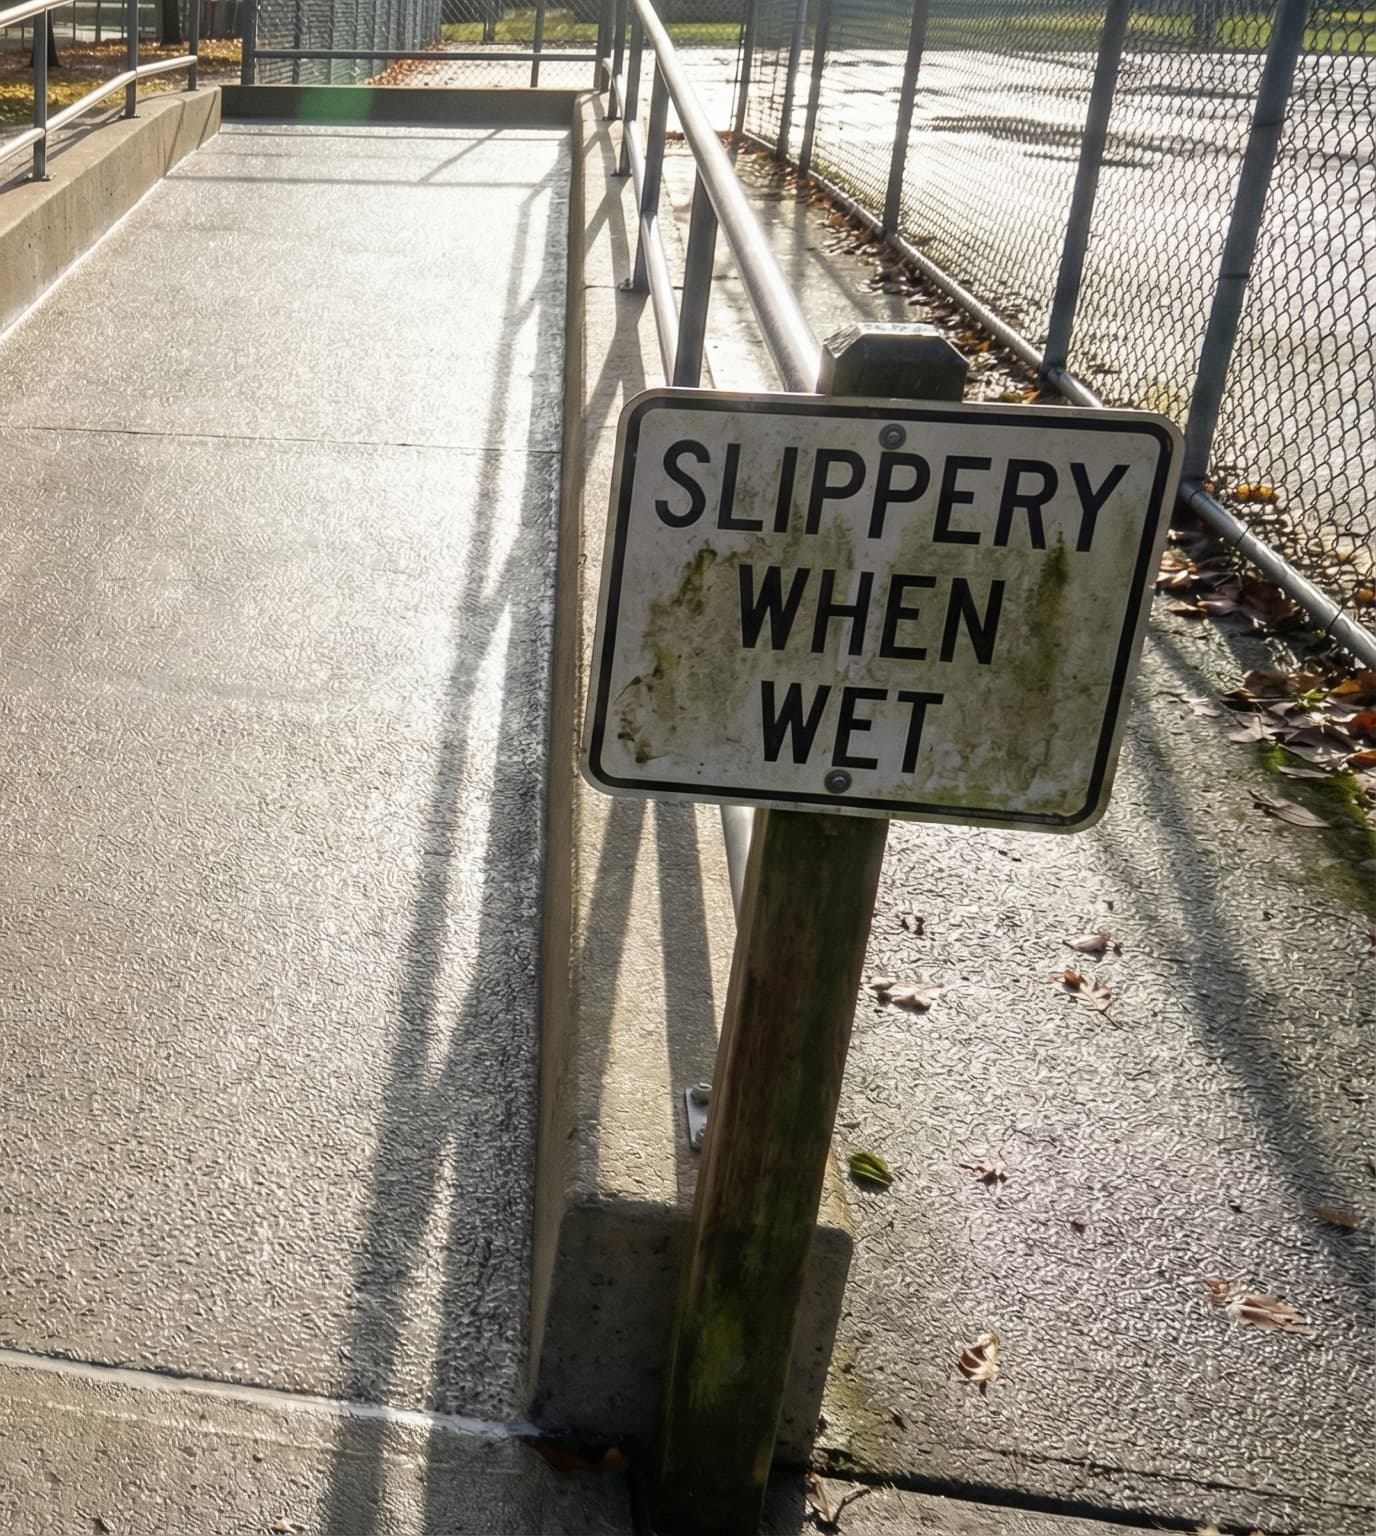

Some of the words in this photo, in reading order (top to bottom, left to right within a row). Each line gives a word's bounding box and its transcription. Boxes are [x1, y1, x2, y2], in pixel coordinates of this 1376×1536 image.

[654, 439, 1130, 552] SLIPPERY
[738, 564, 1005, 664] WHEN
[760, 680, 944, 773] WET
